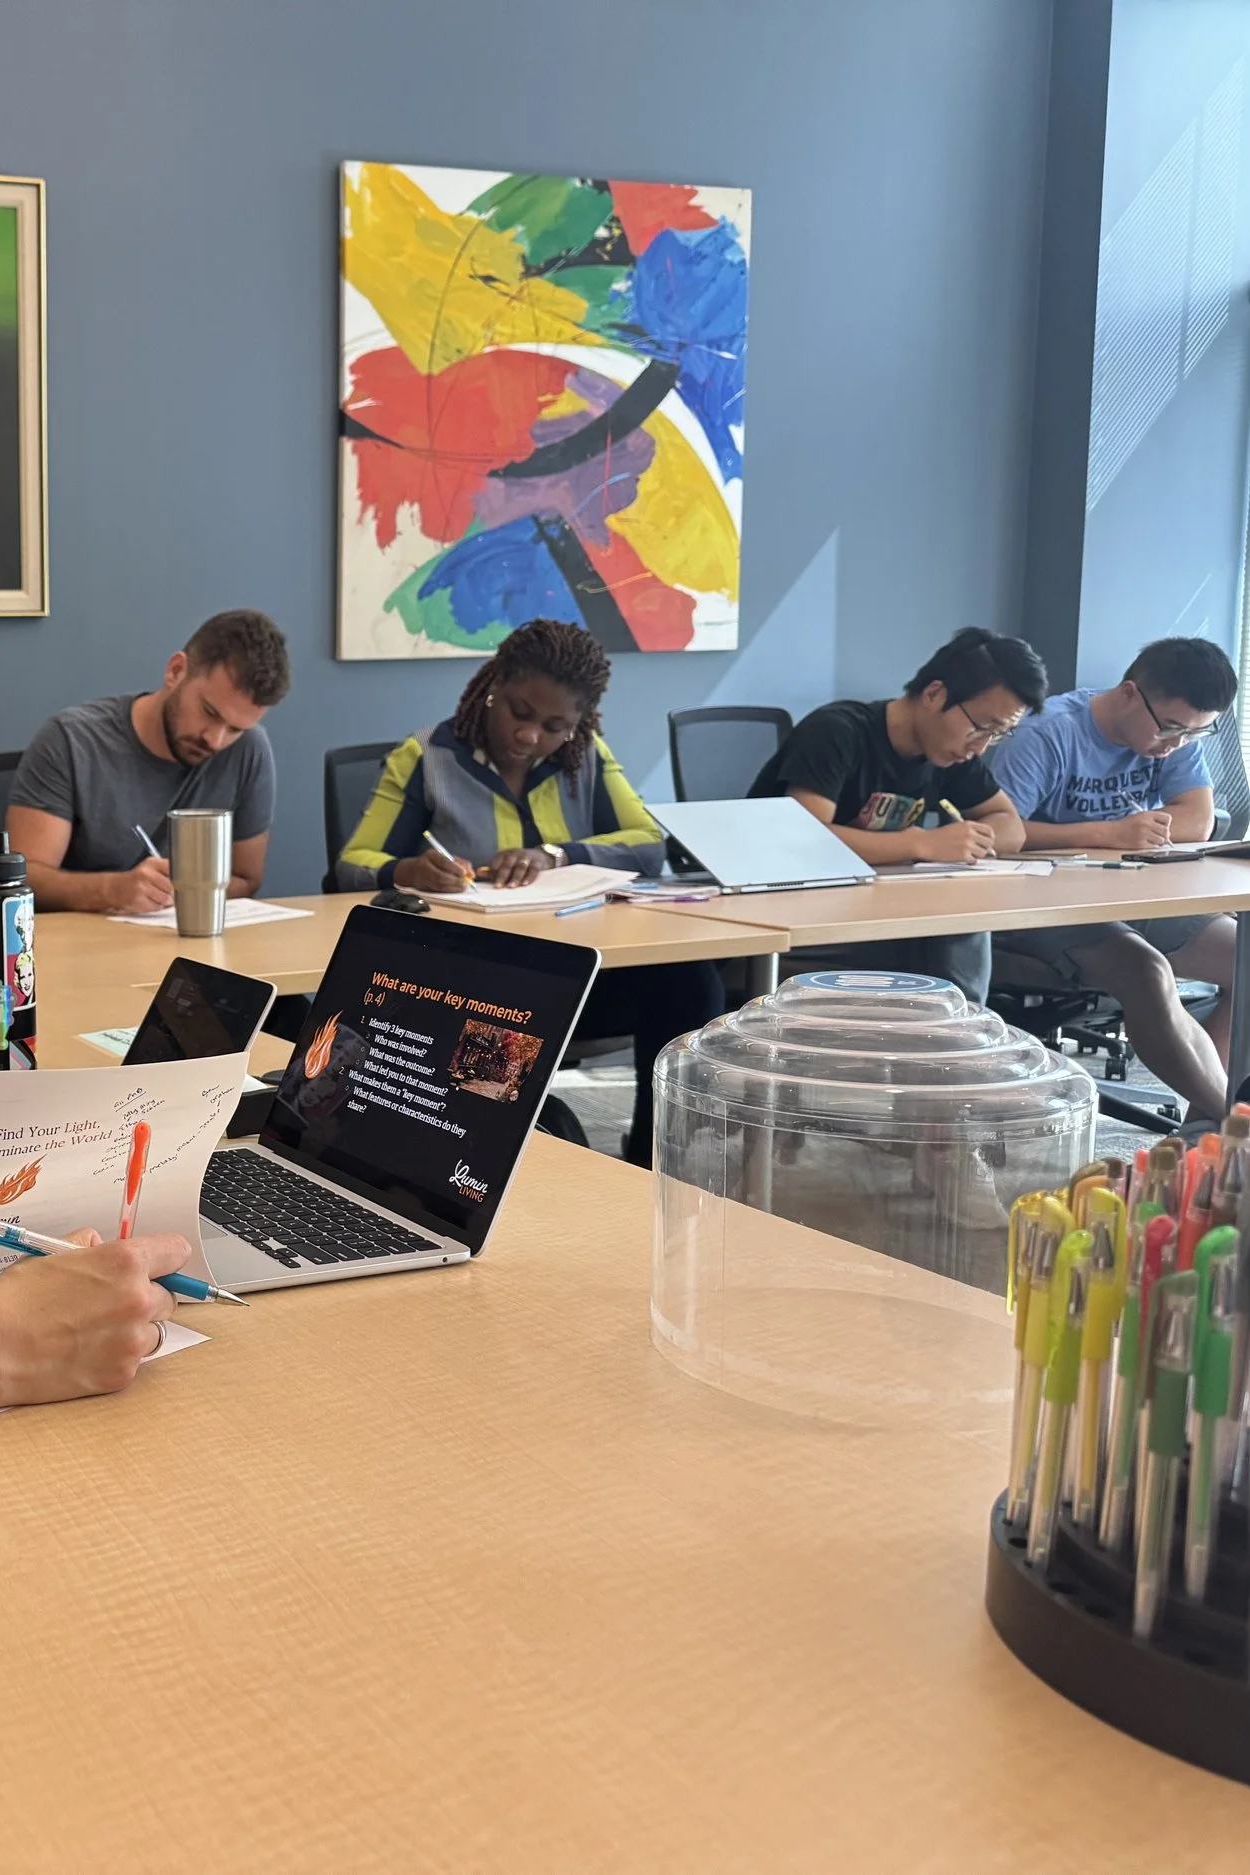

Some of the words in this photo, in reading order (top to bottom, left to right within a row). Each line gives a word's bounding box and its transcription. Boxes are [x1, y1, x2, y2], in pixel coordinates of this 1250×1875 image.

[371, 971, 399, 990] What
[399, 982, 417, 995] are
[416, 985, 444, 1002] your
[444, 990, 466, 1010] key
[466, 998, 532, 1025] moments?
[368, 1017, 392, 1034] Identify
[394, 1026, 406, 1038] key
[405, 1030, 434, 1045] moments
[374, 1033, 388, 1046] Who
[387, 1039, 399, 1050] was
[398, 1041, 428, 1058] involved?
[369, 1046, 385, 1060] What
[384, 1053, 396, 1063] was
[395, 1056, 406, 1066] the
[405, 1061, 436, 1076] outcome?
[348, 1069, 364, 1082] What
[362, 1076, 381, 1090] makes
[380, 1081, 396, 1094] them
[363, 1059, 380, 1073] What
[379, 1064, 388, 1075] led
[386, 1069, 399, 1081] you
[398, 1073, 406, 1082] to
[405, 1074, 419, 1087] that
[418, 1081, 449, 1097] moment?
[347, 1099, 367, 1114] share?
[353, 1085, 369, 1099] What
[367, 1091, 392, 1109] features
[390, 1102, 399, 1112] or
[397, 1105, 442, 1128] characteristics
[441, 1120, 451, 1132] do
[450, 1123, 467, 1139] they
[28, 1125, 61, 1138] Your
[64, 1119, 101, 1134] Light,
[44, 1139, 66, 1151] the
[71, 1130, 113, 1145] World
[448, 1159, 488, 1193] Lumin
[459, 1185, 484, 1203] LIVING
